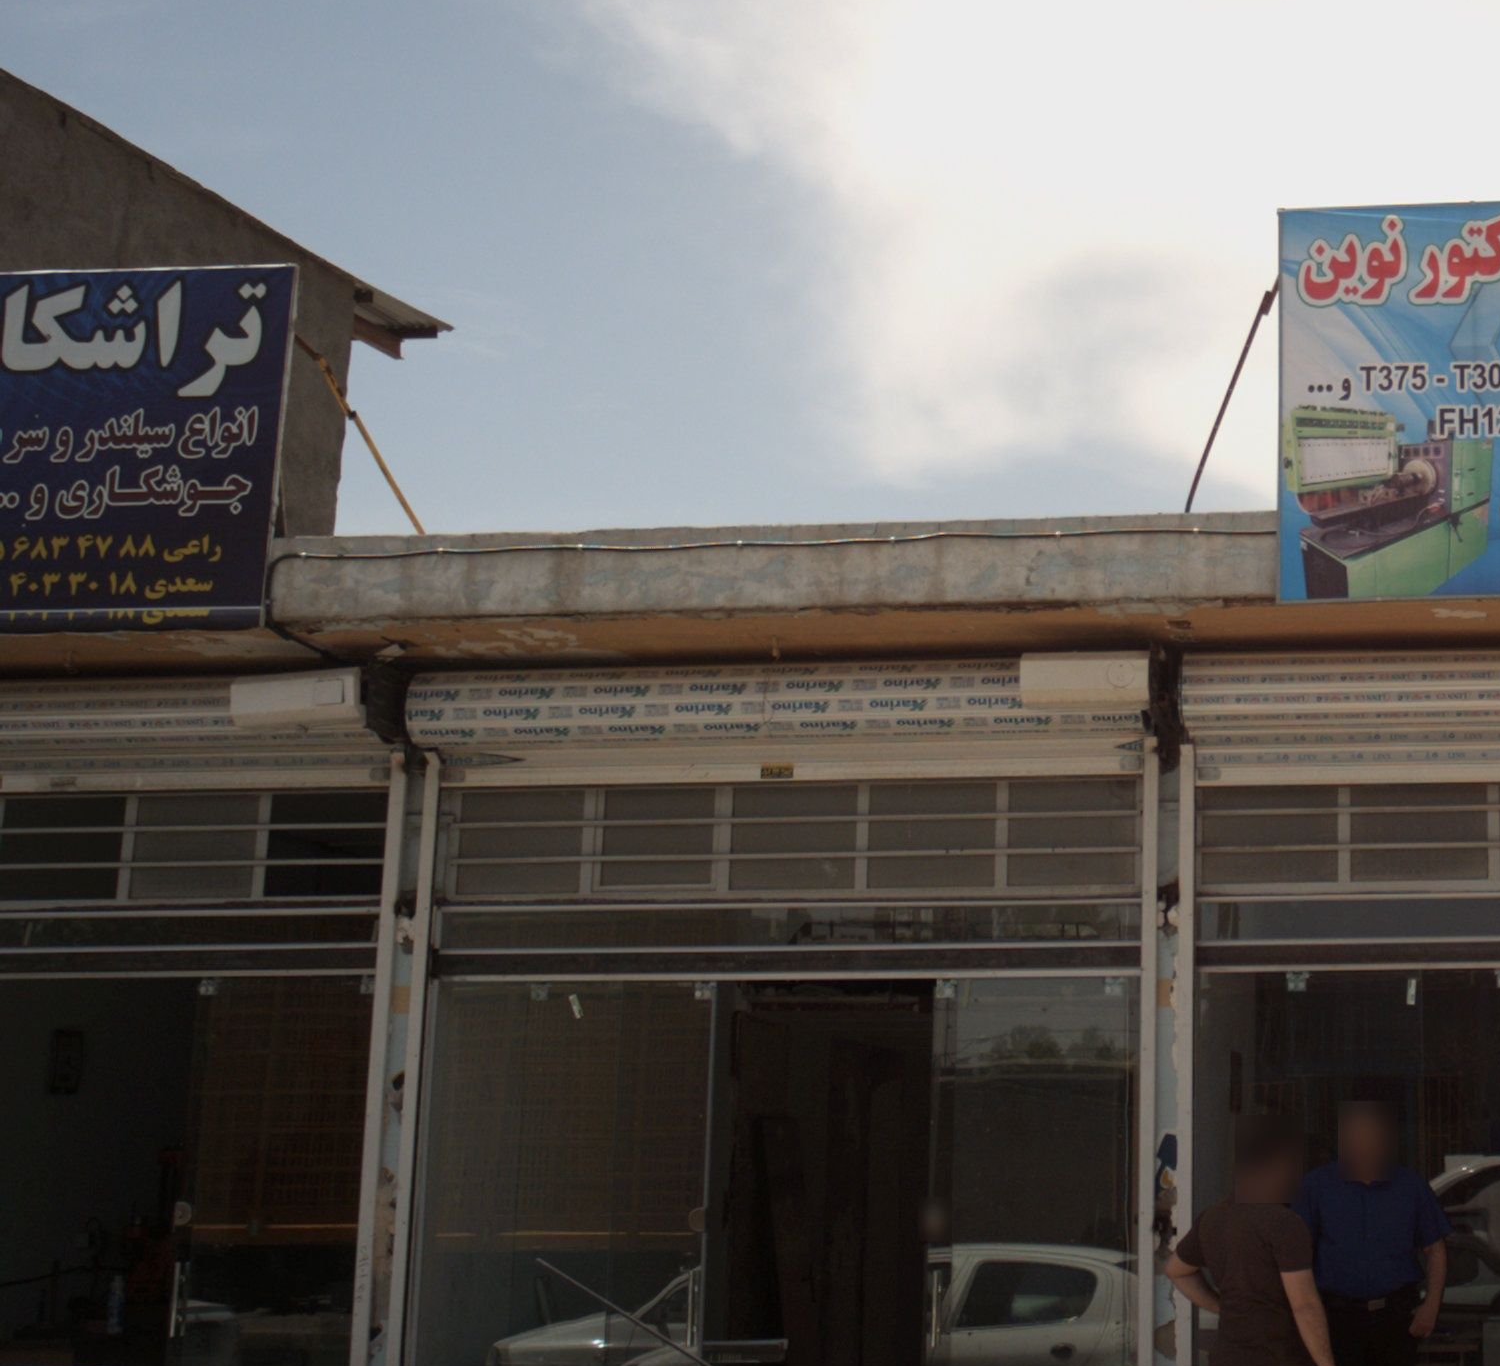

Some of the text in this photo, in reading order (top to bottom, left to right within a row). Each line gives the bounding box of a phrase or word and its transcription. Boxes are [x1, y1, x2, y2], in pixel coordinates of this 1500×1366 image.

[1299, 216, 1405, 304] نوین
[1358, 363, 1429, 394] T375
[49, 426, 74, 463] و
[74, 408, 176, 462] سیلندر
[178, 405, 260, 459] انواع
[24, 482, 49, 521] و
[55, 464, 253, 519] جوشکاری
[162, 533, 223, 563] راعی
[144, 575, 214, 600] سعدی
